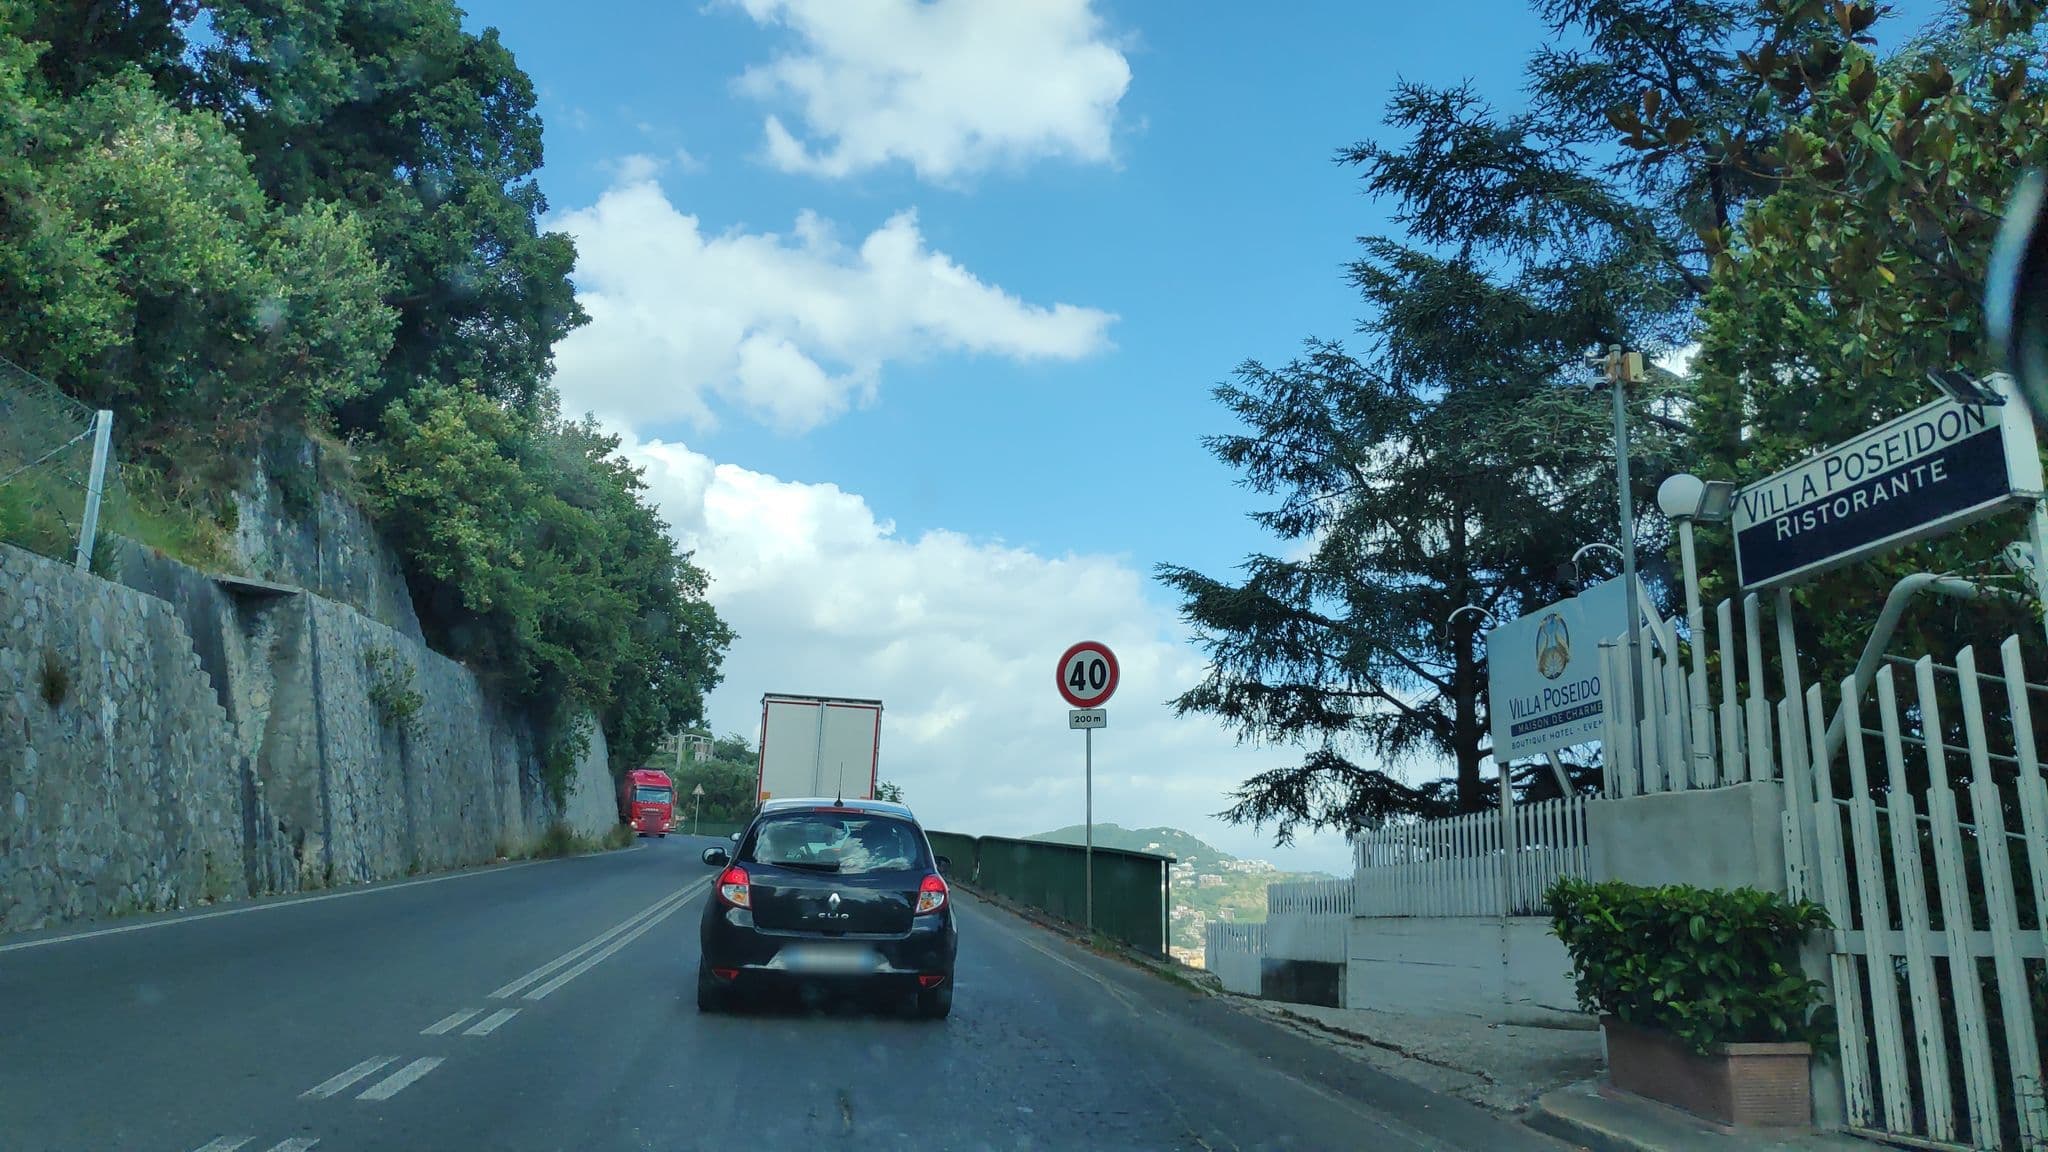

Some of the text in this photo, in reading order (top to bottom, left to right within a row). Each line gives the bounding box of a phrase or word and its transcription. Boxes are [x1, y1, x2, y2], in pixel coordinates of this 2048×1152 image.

[1742, 402, 1986, 524] VILLA POSEIDON
[1776, 458, 1948, 541] RISTORANTE
[1069, 658, 1107, 691] 40
[1509, 676, 1601, 720] VILLA POSEIDO
[1518, 702, 1602, 733] MAISON DE CHARME
[1512, 734, 1547, 750] BOUTIQUE
[1550, 727, 1574, 740] HOTEL
